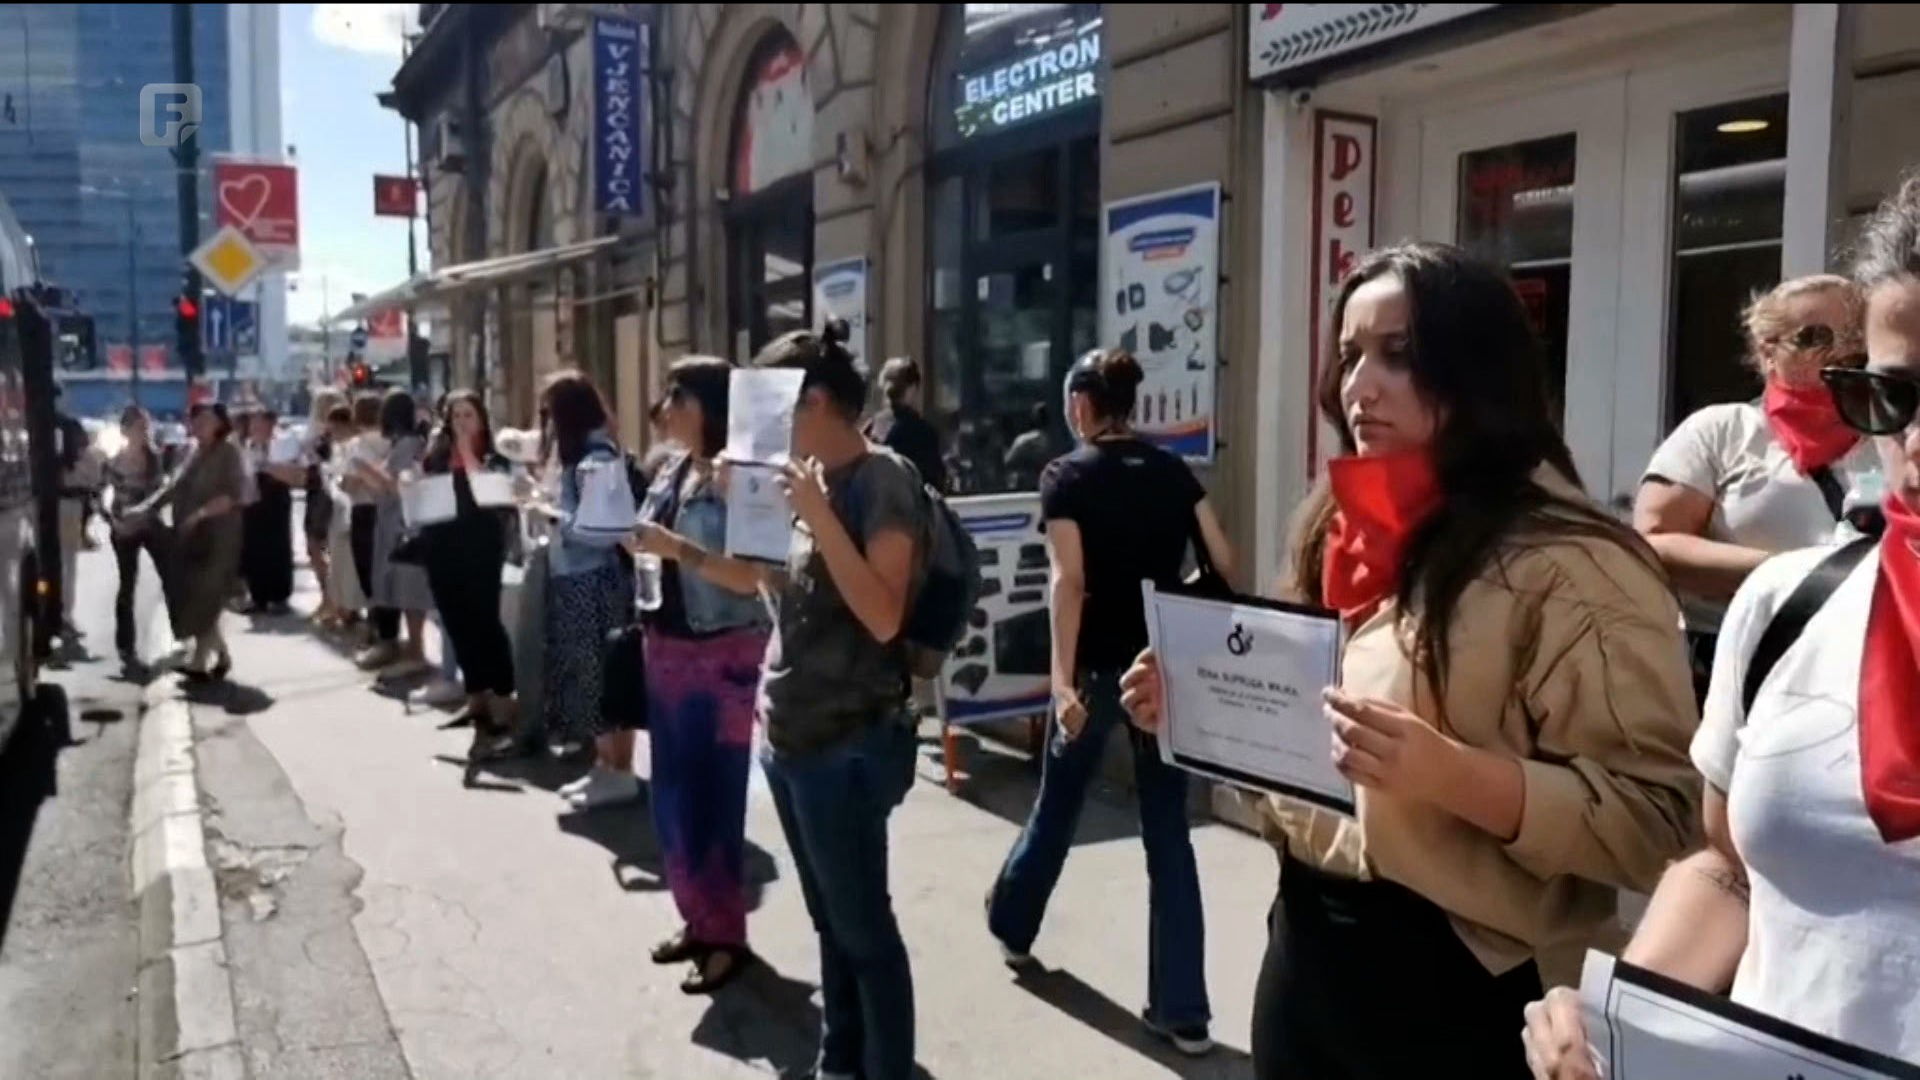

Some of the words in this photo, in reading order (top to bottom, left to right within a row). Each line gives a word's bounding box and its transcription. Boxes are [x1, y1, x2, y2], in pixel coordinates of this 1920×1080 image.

[965, 33, 1100, 103] ELECTRON
[992, 71, 1097, 126] CENTER
[1330, 133, 1362, 286] Pek
